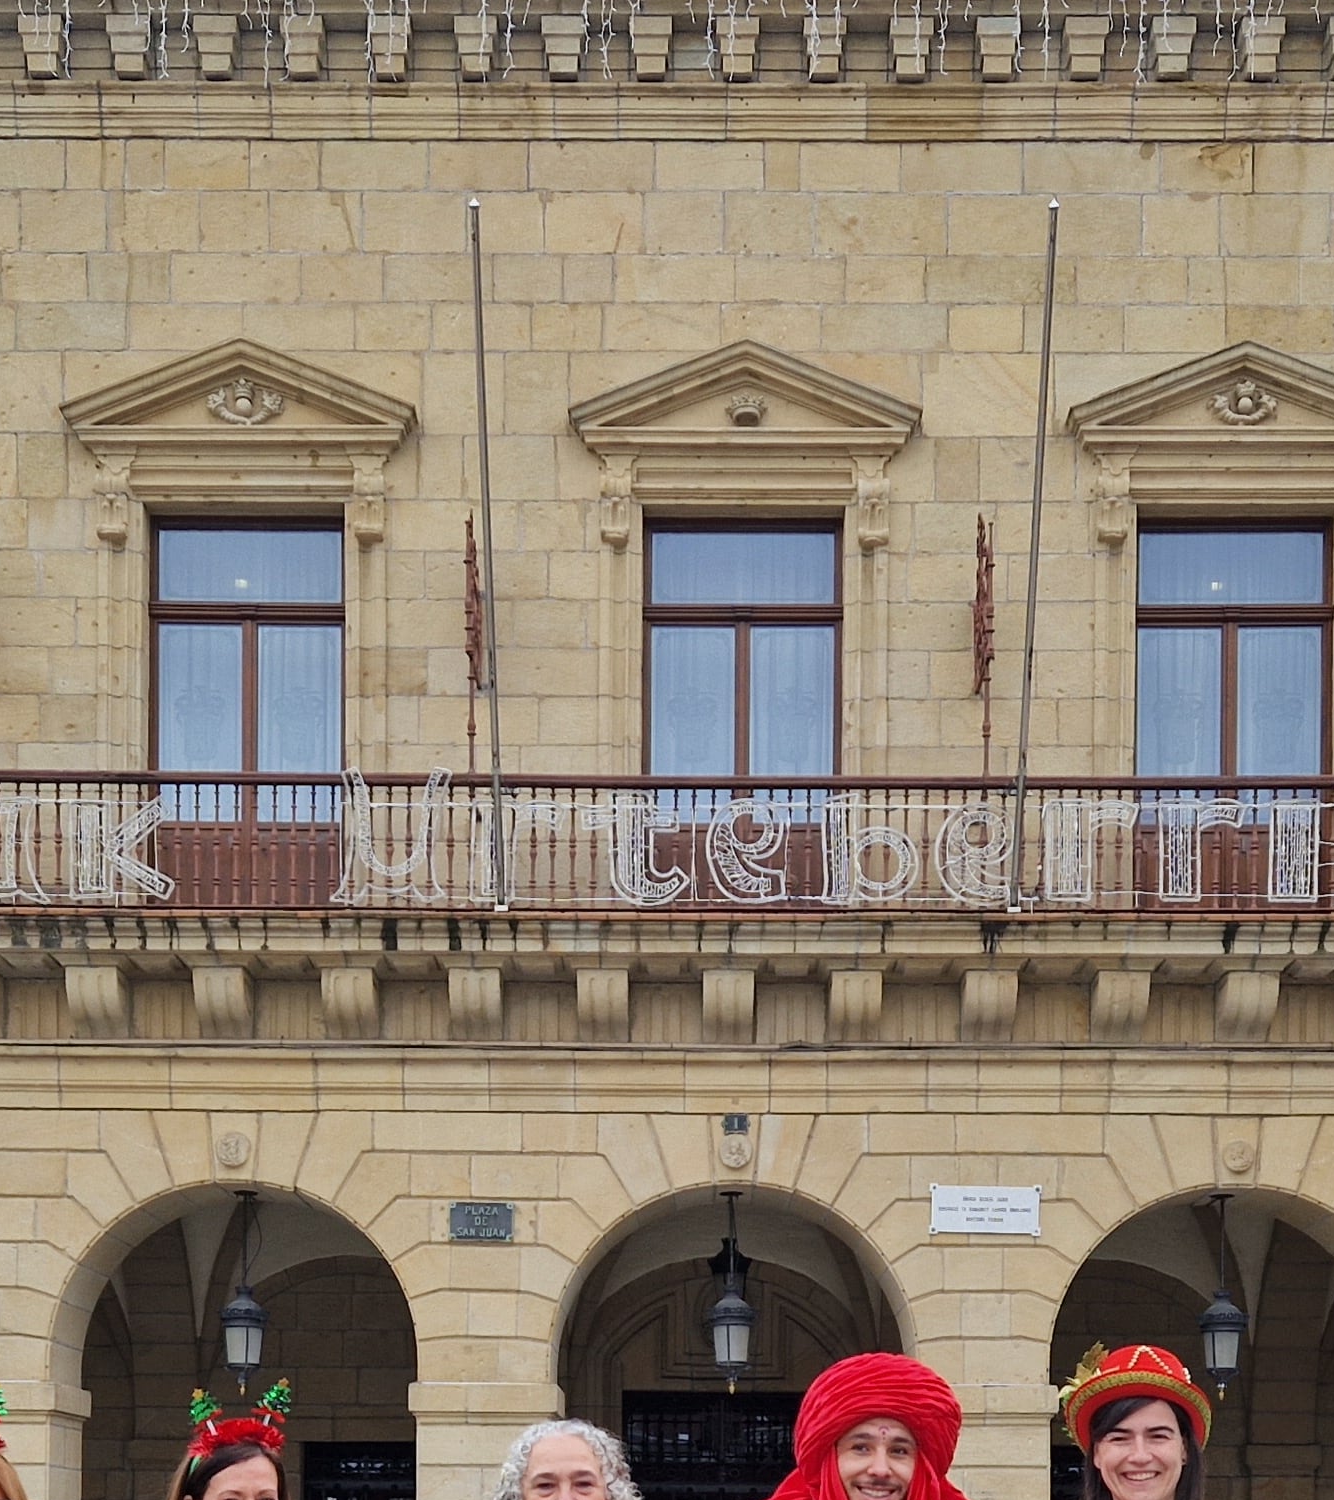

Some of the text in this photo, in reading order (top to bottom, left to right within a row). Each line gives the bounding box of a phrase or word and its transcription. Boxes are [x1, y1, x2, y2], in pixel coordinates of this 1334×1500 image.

[464, 1205, 499, 1216] PLAZA
[474, 1216, 488, 1226] DE
[457, 1226, 506, 1238] SAN JUAN
